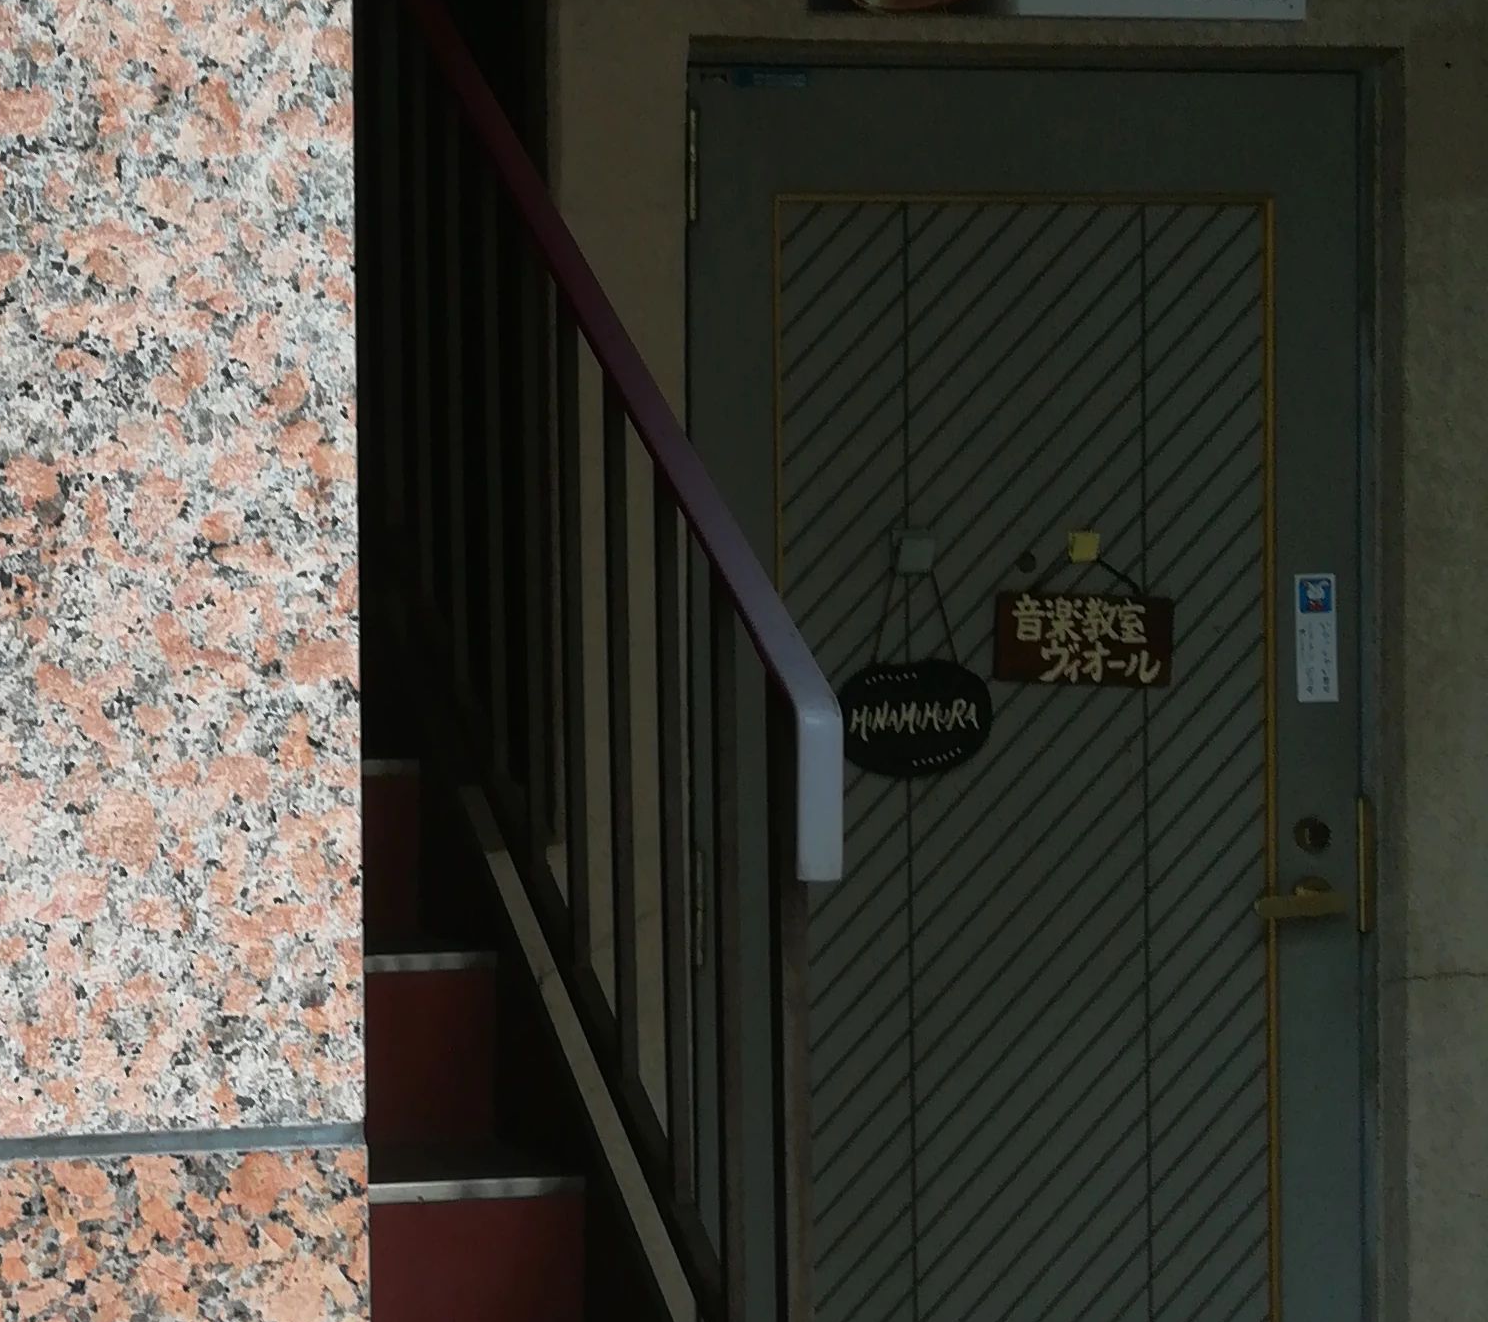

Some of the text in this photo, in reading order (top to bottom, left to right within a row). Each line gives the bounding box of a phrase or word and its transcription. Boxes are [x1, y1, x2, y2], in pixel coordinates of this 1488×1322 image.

[1011, 593, 1148, 644] 音楽教室
[1039, 639, 1161, 684] ヴィオール
